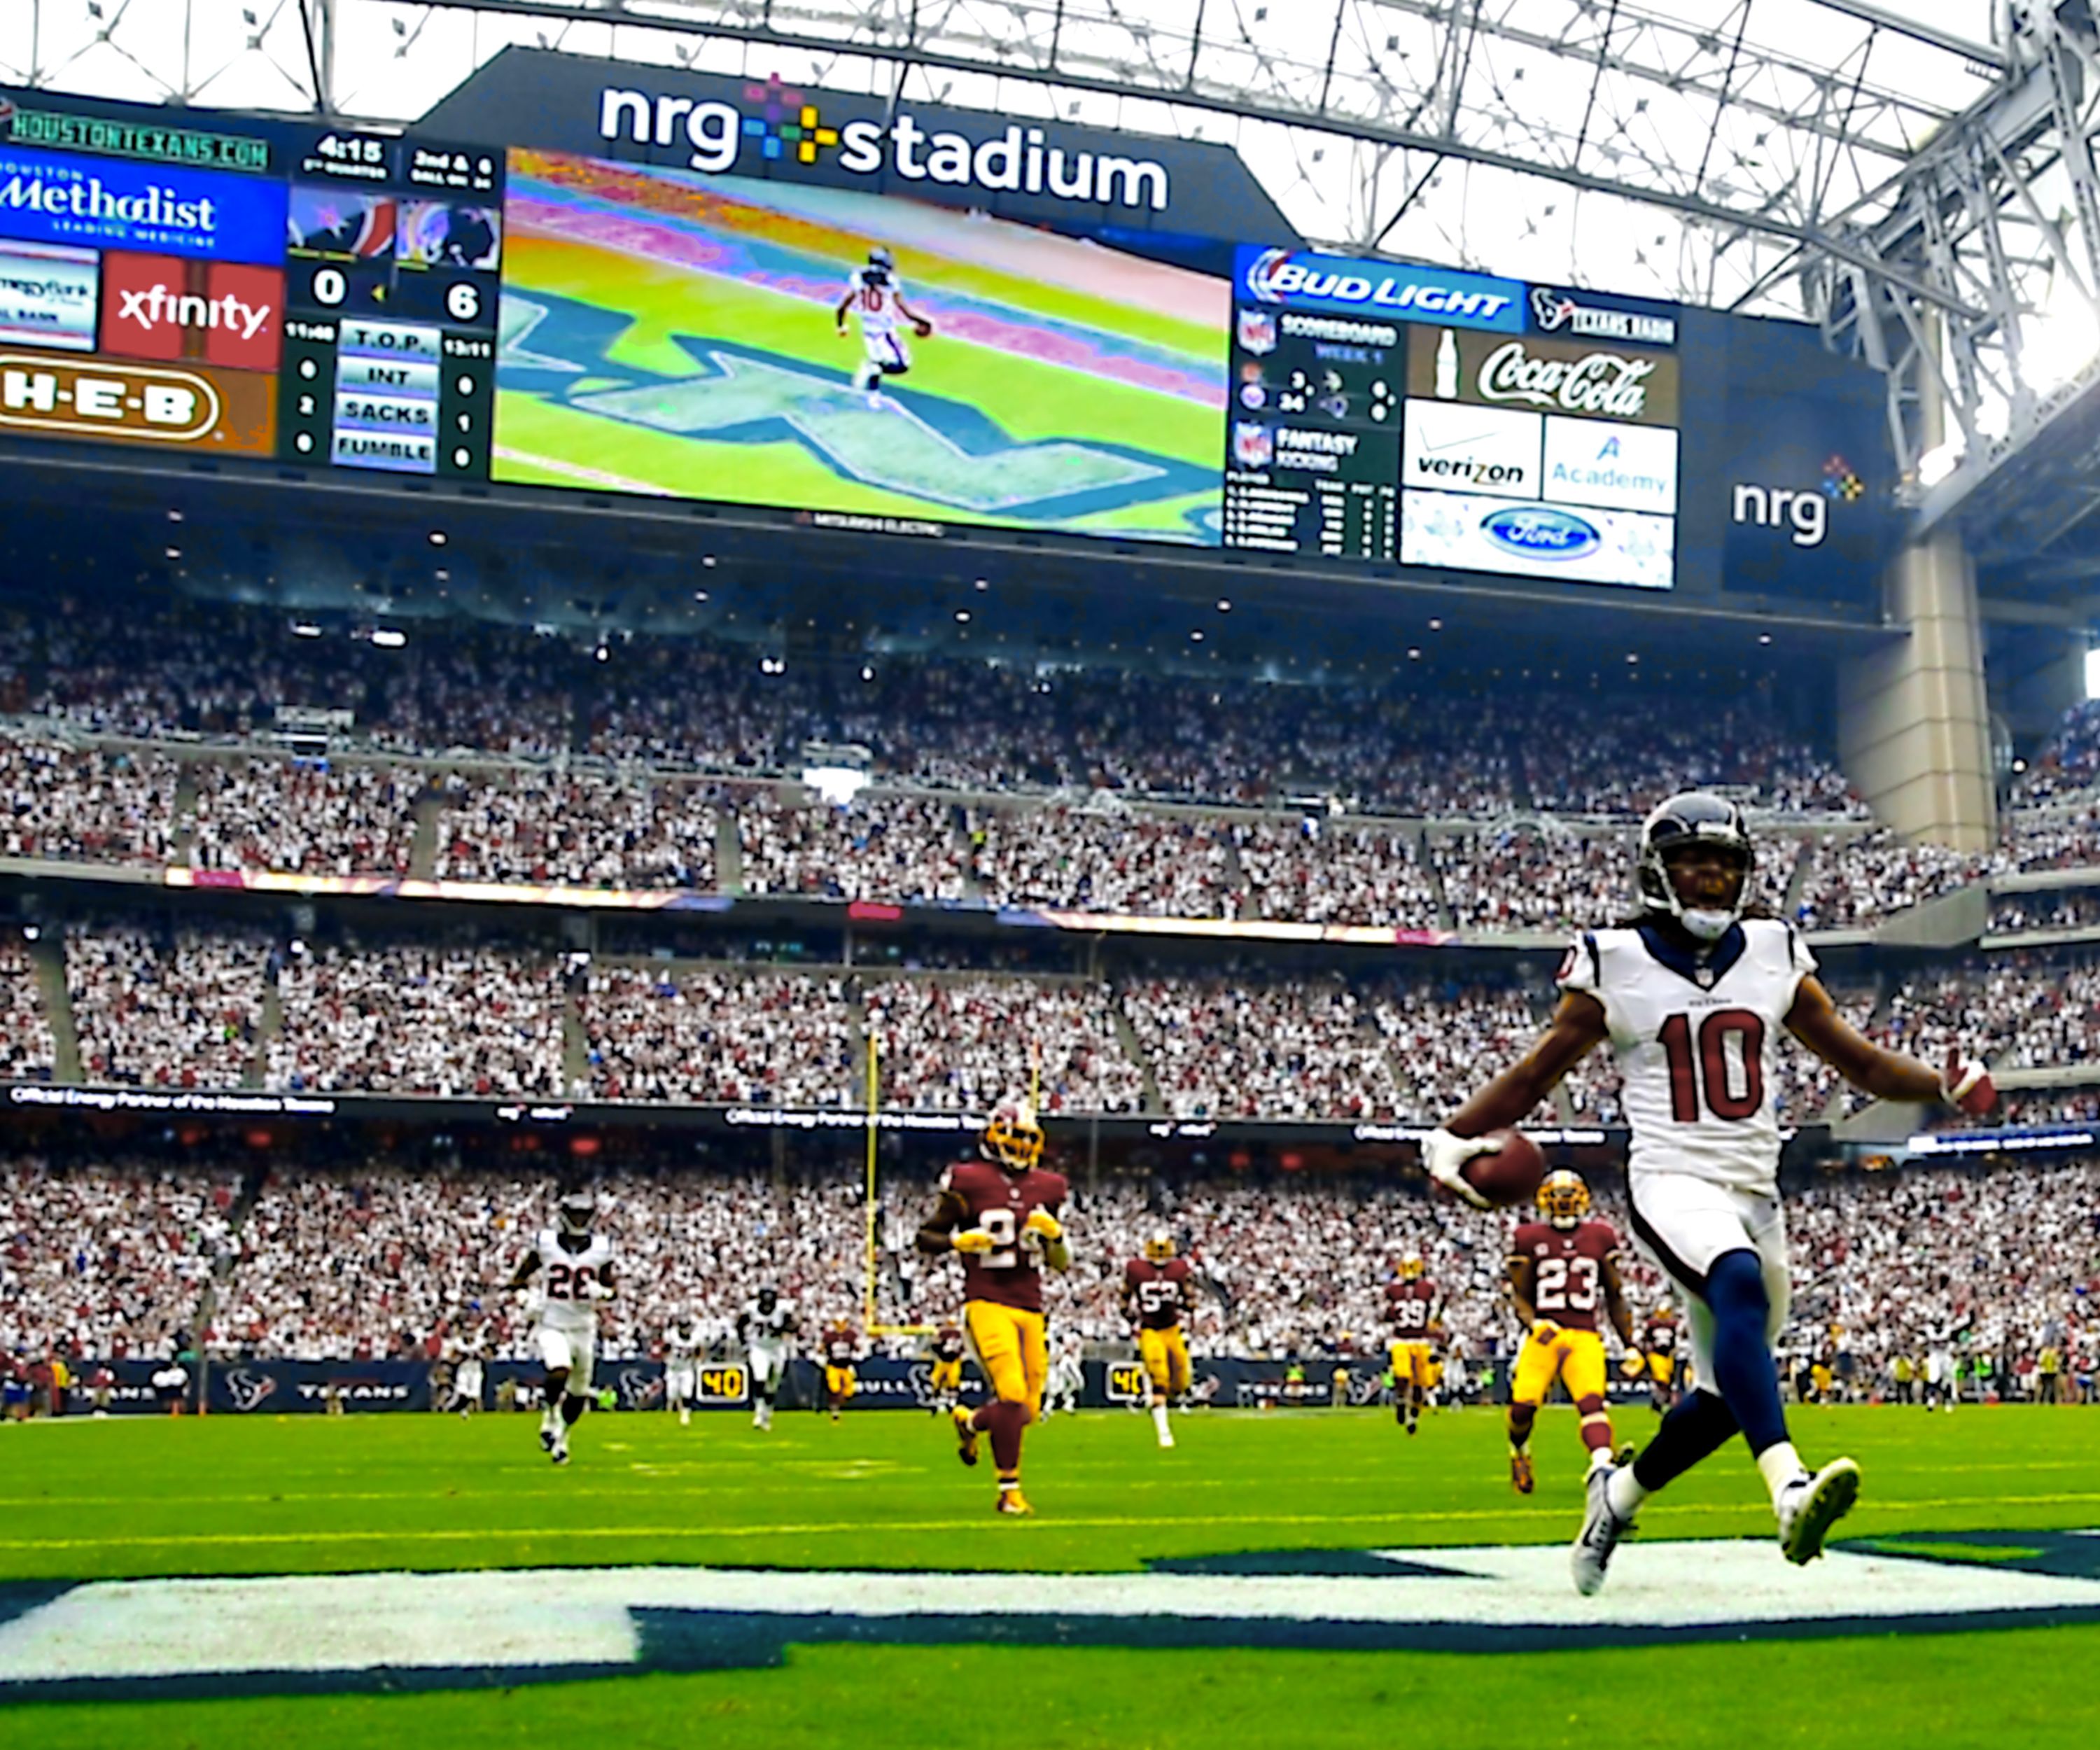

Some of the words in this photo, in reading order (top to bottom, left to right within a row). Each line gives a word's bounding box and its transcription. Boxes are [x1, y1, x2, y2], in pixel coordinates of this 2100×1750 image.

[317, 135, 383, 163] 4:15
[601, 86, 740, 172] nrg
[841, 114, 1168, 210] stadium
[0, 175, 216, 232] Methodist
[314, 269, 346, 304] 0
[448, 284, 480, 319] 6
[1269, 263, 1371, 301] BUD
[1373, 277, 1510, 317] LIGHT
[118, 284, 271, 340] xfinity
[355, 330, 428, 354] T.O.P.
[1280, 314, 1398, 347] SCOREBOARD
[368, 368, 411, 385] INT
[1478, 342, 1656, 417] Coca-Cola
[4, 370, 196, 424] H-E-B
[344, 401, 429, 425] SACKS
[338, 438, 432, 461] FUMBLE
[1276, 428, 1359, 455] FANTASY
[1418, 456, 1525, 486] verizon
[1552, 463, 1668, 496] Academy
[1506, 513, 1572, 545] Ford
[1734, 484, 1826, 545] nrg
[1656, 1008, 1765, 1124] 10
[1536, 1259, 1598, 1311] 23
[702, 1369, 742, 1398] 40
